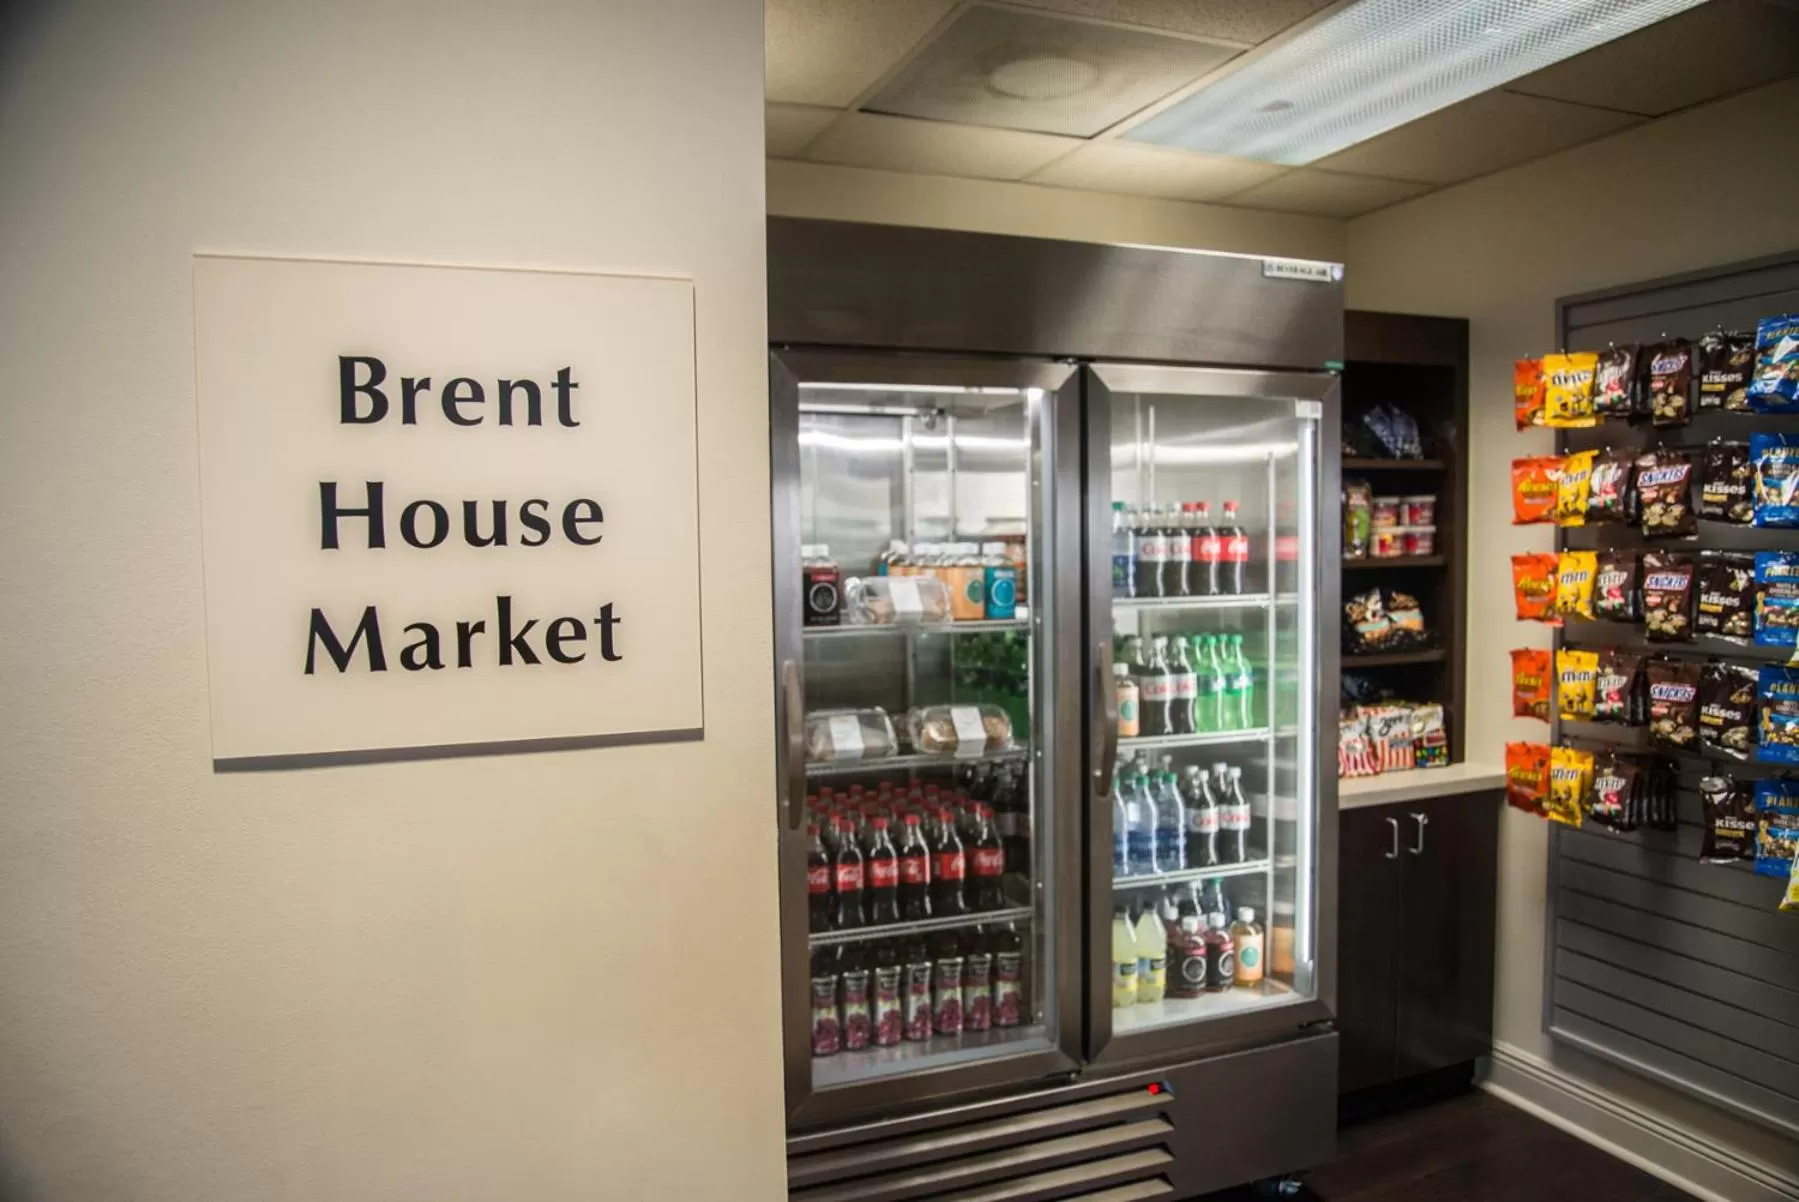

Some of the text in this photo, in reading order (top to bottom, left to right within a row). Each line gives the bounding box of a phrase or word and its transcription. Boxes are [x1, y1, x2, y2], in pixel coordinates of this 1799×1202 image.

[338, 355, 581, 428] Brent
[319, 481, 604, 550] House
[303, 595, 623, 675] Market
